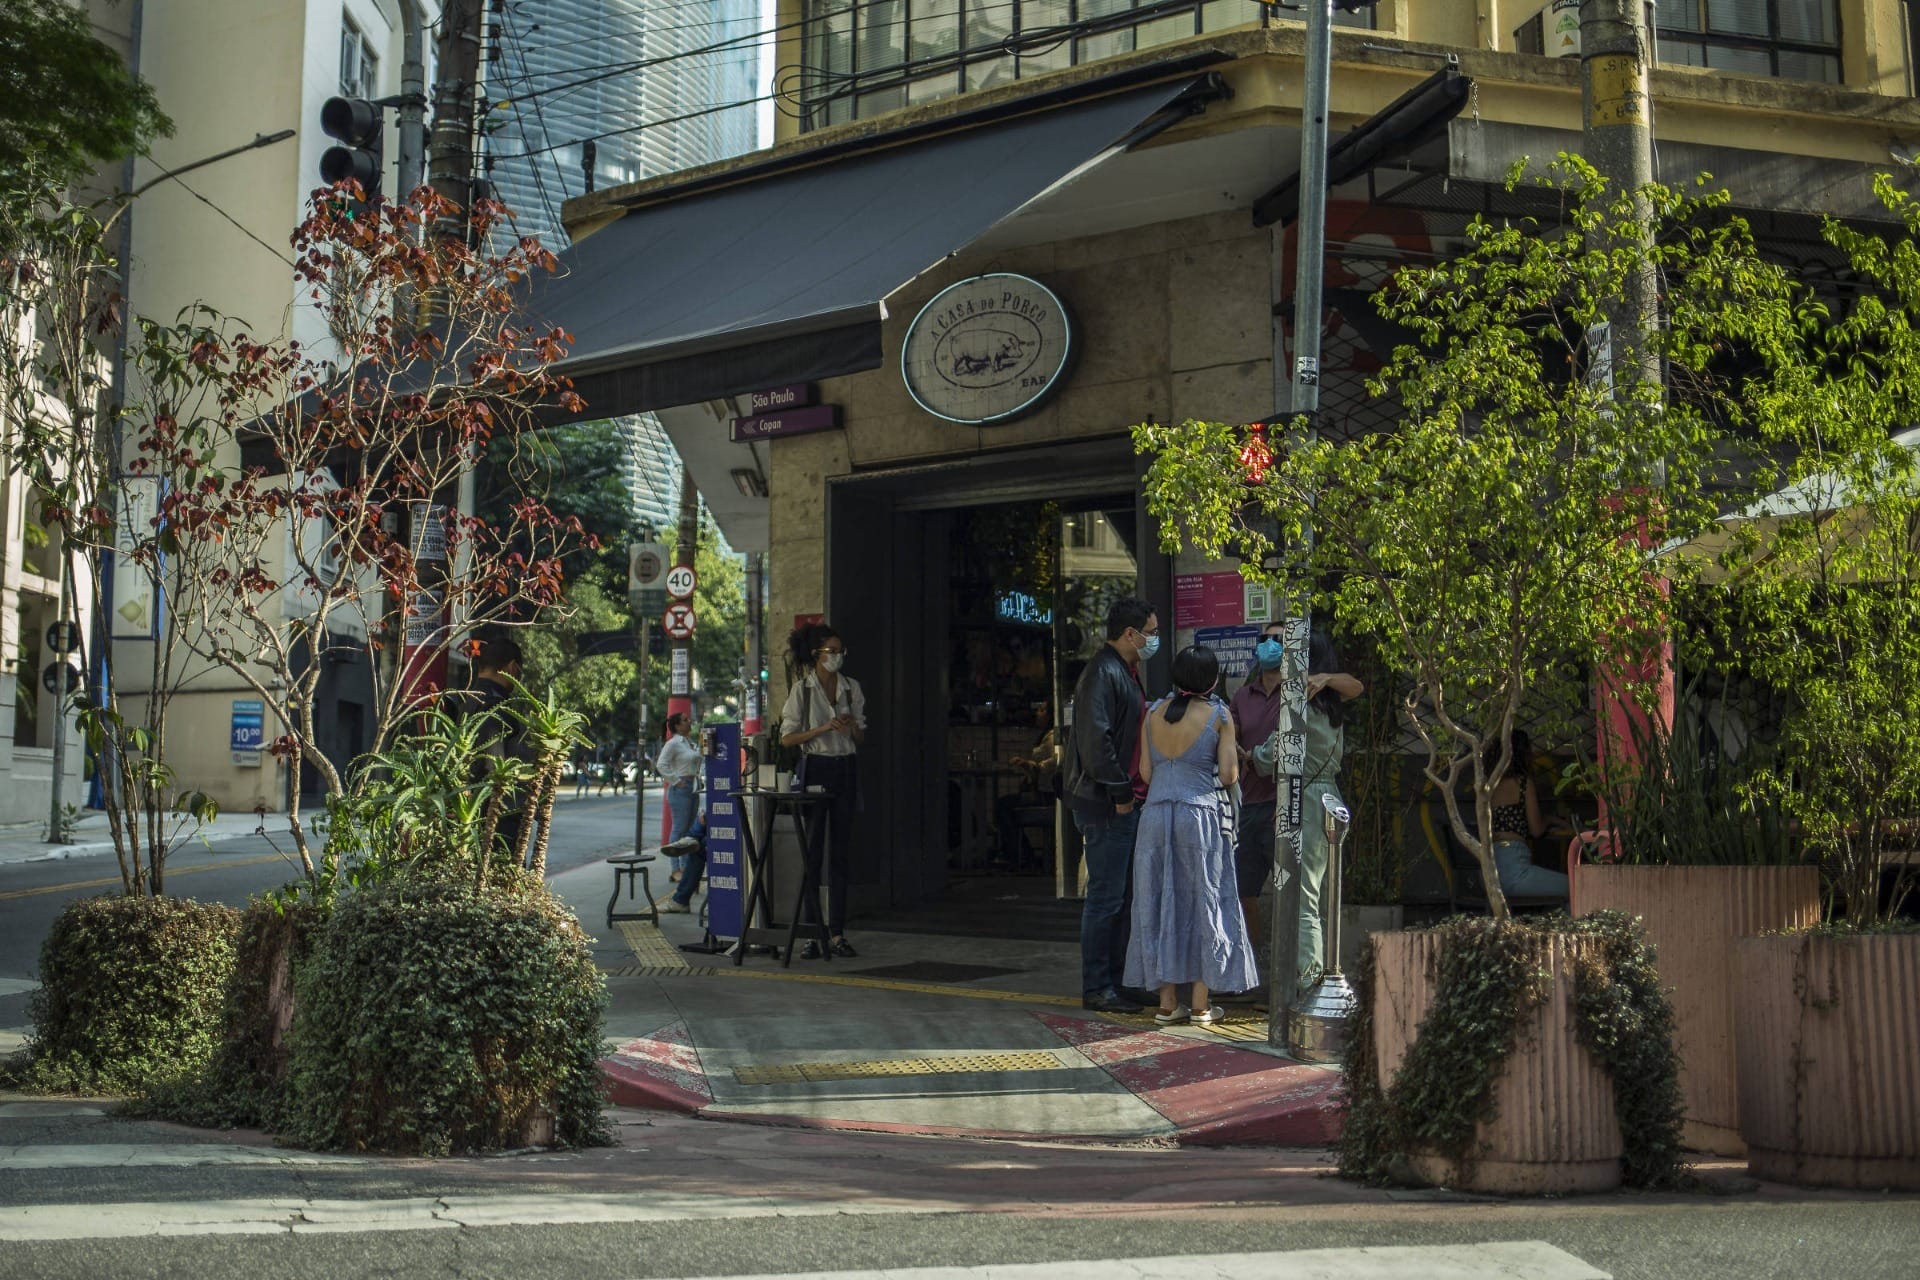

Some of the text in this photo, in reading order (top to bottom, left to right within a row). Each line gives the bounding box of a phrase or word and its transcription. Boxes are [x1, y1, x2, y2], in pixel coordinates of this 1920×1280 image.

[930, 330, 939, 340] A
[936, 301, 975, 329] CASA
[1001, 291, 1047, 323] PORCO
[1022, 375, 1047, 388] BAR
[752, 388, 795, 408] São Paulo
[759, 419, 781, 432] Copan
[669, 572, 692, 588] 40
